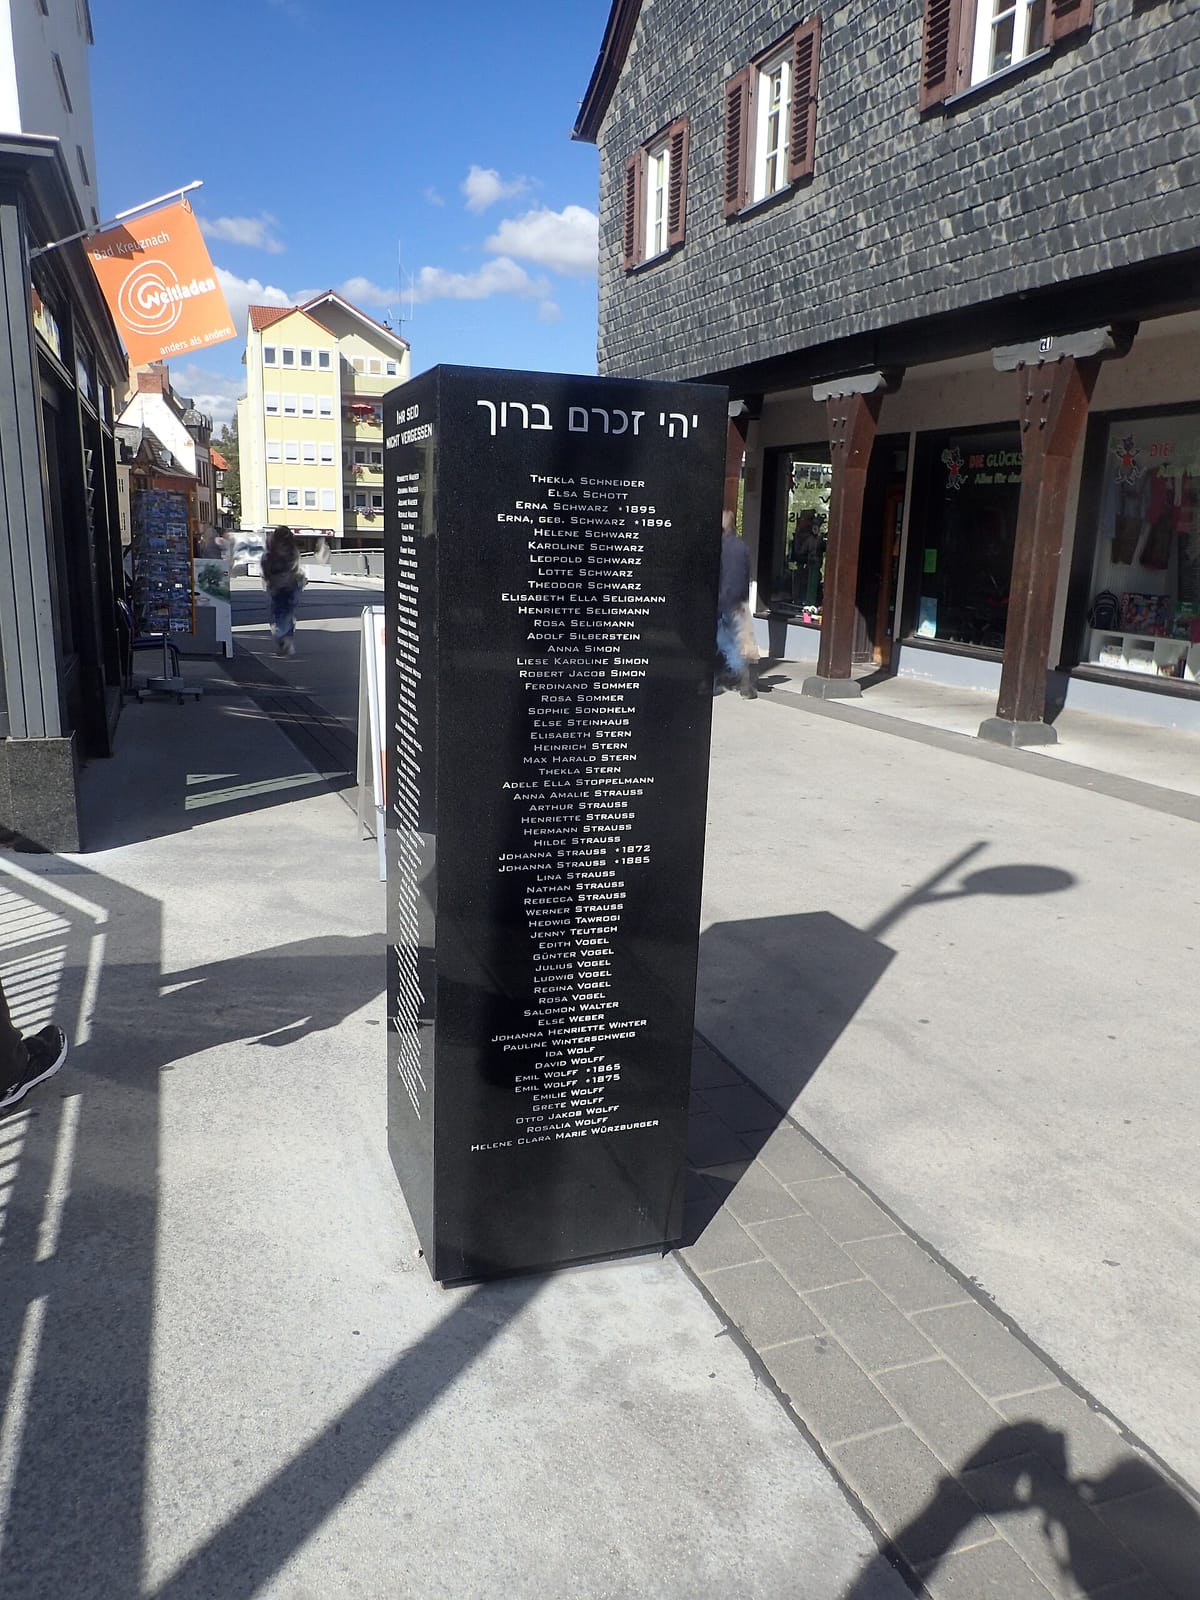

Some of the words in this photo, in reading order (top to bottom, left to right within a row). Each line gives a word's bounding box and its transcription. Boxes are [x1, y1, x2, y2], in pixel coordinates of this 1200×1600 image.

[93, 246, 114, 261] Bad
[116, 231, 170, 255] Kreuznach
[143, 277, 216, 308] Weltladen
[160, 341, 188, 355] anders
[190, 337, 202, 348] als
[204, 326, 231, 343] andere
[397, 409, 405, 425] IHR
[406, 404, 419, 422] SEID
[476, 399, 554, 436] ברוך
[568, 406, 646, 436] זכרם
[659, 412, 699, 439] יהי
[386, 434, 400, 450] NICHT
[401, 423, 432, 445] VERGESSEN
[529, 474, 575, 484] THEKLA
[580, 477, 645, 488] SCHNEIDER
[548, 488, 578, 498] ELSA
[583, 490, 629, 500] SCHOTT
[515, 500, 548, 510] ERNA
[553, 502, 608, 512] SCHWARZ
[570, 516, 625, 526] SCHWARZ
[534, 528, 579, 538] HELENE
[584, 530, 640, 540] SCHWARZ
[528, 540, 584, 551] KAROLINE
[590, 543, 644, 552] SCHWARZ
[530, 554, 582, 564] LEOPOLD
[588, 556, 642, 565] SCHWARZ
[538, 567, 574, 576] LOTTE
[579, 568, 633, 578] SCHWARZ
[527, 580, 582, 589] THEODOR
[588, 581, 642, 590] SCHWARZ
[501, 592, 564, 602] ELISABETH
[570, 594, 598, 602] ELLA
[602, 594, 666, 603] SELIGMANN
[518, 606, 581, 615] HENRIETTE
[586, 606, 650, 616] SELIGMANN
[534, 619, 566, 627] ROSA
[570, 619, 635, 628] SELIGMANN
[526, 632, 565, 640] ADOLF
[569, 632, 641, 641] SILBERSTEIN
[547, 645, 580, 653] ANNA
[584, 645, 621, 653] SIMON
[516, 657, 549, 666] LIESE
[554, 657, 609, 665] KAROLINE
[613, 657, 649, 665] SIMON
[519, 670, 564, 678] ROBERT
[568, 670, 606, 678] JACOB
[610, 669, 646, 677] SIMON
[525, 682, 588, 690] FERDINAND
[593, 682, 640, 690] SOMMER
[577, 694, 624, 702] SOMMER
[528, 707, 570, 715] SOPHIE
[534, 719, 562, 727] ELSE
[567, 718, 630, 727] STEINHAUS
[530, 732, 591, 740] ELISABETH
[595, 730, 632, 738] STERN
[534, 744, 587, 752] HEINRICH
[591, 742, 628, 750] STERN
[523, 756, 548, 764] MAX
[552, 755, 597, 763] HARALD
[600, 754, 637, 762] STERN
[538, 768, 580, 776] THEKLA
[585, 766, 622, 774] STERN
[502, 781, 538, 790] ADELE
[543, 780, 571, 788] ELLA
[575, 776, 654, 786] STOPPELMANN
[513, 793, 546, 801] ANNA
[549, 791, 590, 799] AMALIE
[594, 788, 644, 797] STRAUSS
[529, 804, 574, 812] ARTHUR
[578, 801, 628, 810] STRAUSS
[521, 814, 581, 824] HENRIETTE
[586, 812, 636, 821] STRAUSS
[524, 827, 578, 836] HERMANN
[582, 823, 632, 833] STRAUSS
[534, 839, 566, 847] HILDE
[571, 836, 621, 845] STRAUSS
[498, 851, 552, 861] JOHANNA
[557, 848, 607, 857] STRAUSS
[498, 863, 552, 873] JOHANNA
[556, 859, 606, 869] STRAUSS
[536, 874, 562, 882] LINA
[566, 870, 616, 880] STRAUSS
[526, 885, 571, 894] NATHAN
[575, 881, 625, 890] STRAUSS
[524, 896, 574, 905] REBECCA
[578, 892, 627, 902] STRAUSS
[525, 907, 570, 916] WERNER
[575, 903, 624, 913] STRAUSS
[528, 918, 571, 928] HEDWIG
[530, 930, 566, 939] JENNY
[569, 925, 618, 936] TEUTSCH
[538, 940, 571, 950] EDITH
[574, 938, 610, 946] VOGEL
[580, 948, 615, 957] VOGEL
[535, 962, 573, 972] JULIUS
[576, 959, 612, 968] VOGEL
[534, 973, 574, 983] LUDWIG
[577, 970, 612, 979] VOGEL
[534, 984, 574, 994] REGINA
[576, 981, 612, 990] VOGEL
[538, 996, 568, 1004] ROSA
[571, 992, 606, 1001] VOGEL
[524, 1006, 576, 1017] SALOMON
[579, 1001, 619, 1012] WALTER
[538, 1017, 565, 1026] ELSE
[568, 1013, 605, 1023] WEBER
[491, 1031, 544, 1042] JOHANNA
[548, 1023, 606, 1036] HENRIETTE
[608, 1019, 647, 1030] WINTER
[503, 1041, 547, 1052] PAULINE
[551, 1031, 636, 1046] WINTERSCHWEIG
[545, 1050, 563, 1058] IDA
[566, 1046, 596, 1055] WOLF
[535, 1060, 567, 1070] DAVID
[570, 1055, 606, 1065] WOLFF
[515, 1074, 540, 1083] EMIL
[544, 1069, 579, 1079] WOLFF
[514, 1085, 539, 1093] EMIL
[543, 1079, 578, 1089] WOLFF
[533, 1091, 567, 1102] EMILIE
[570, 1086, 605, 1097] WOLFF
[532, 1101, 567, 1112] GRETE
[570, 1096, 605, 1107] WOLFF
[515, 1115, 544, 1124] OTTO
[548, 1110, 582, 1120] JAKOB
[585, 1104, 620, 1115] WOLFF
[526, 1122, 572, 1134] ROSALIA
[574, 1116, 609, 1127] WOLFF
[470, 1140, 513, 1152] HELENE
[517, 1135, 551, 1145] CLARA
[555, 1129, 588, 1140] MARIE
